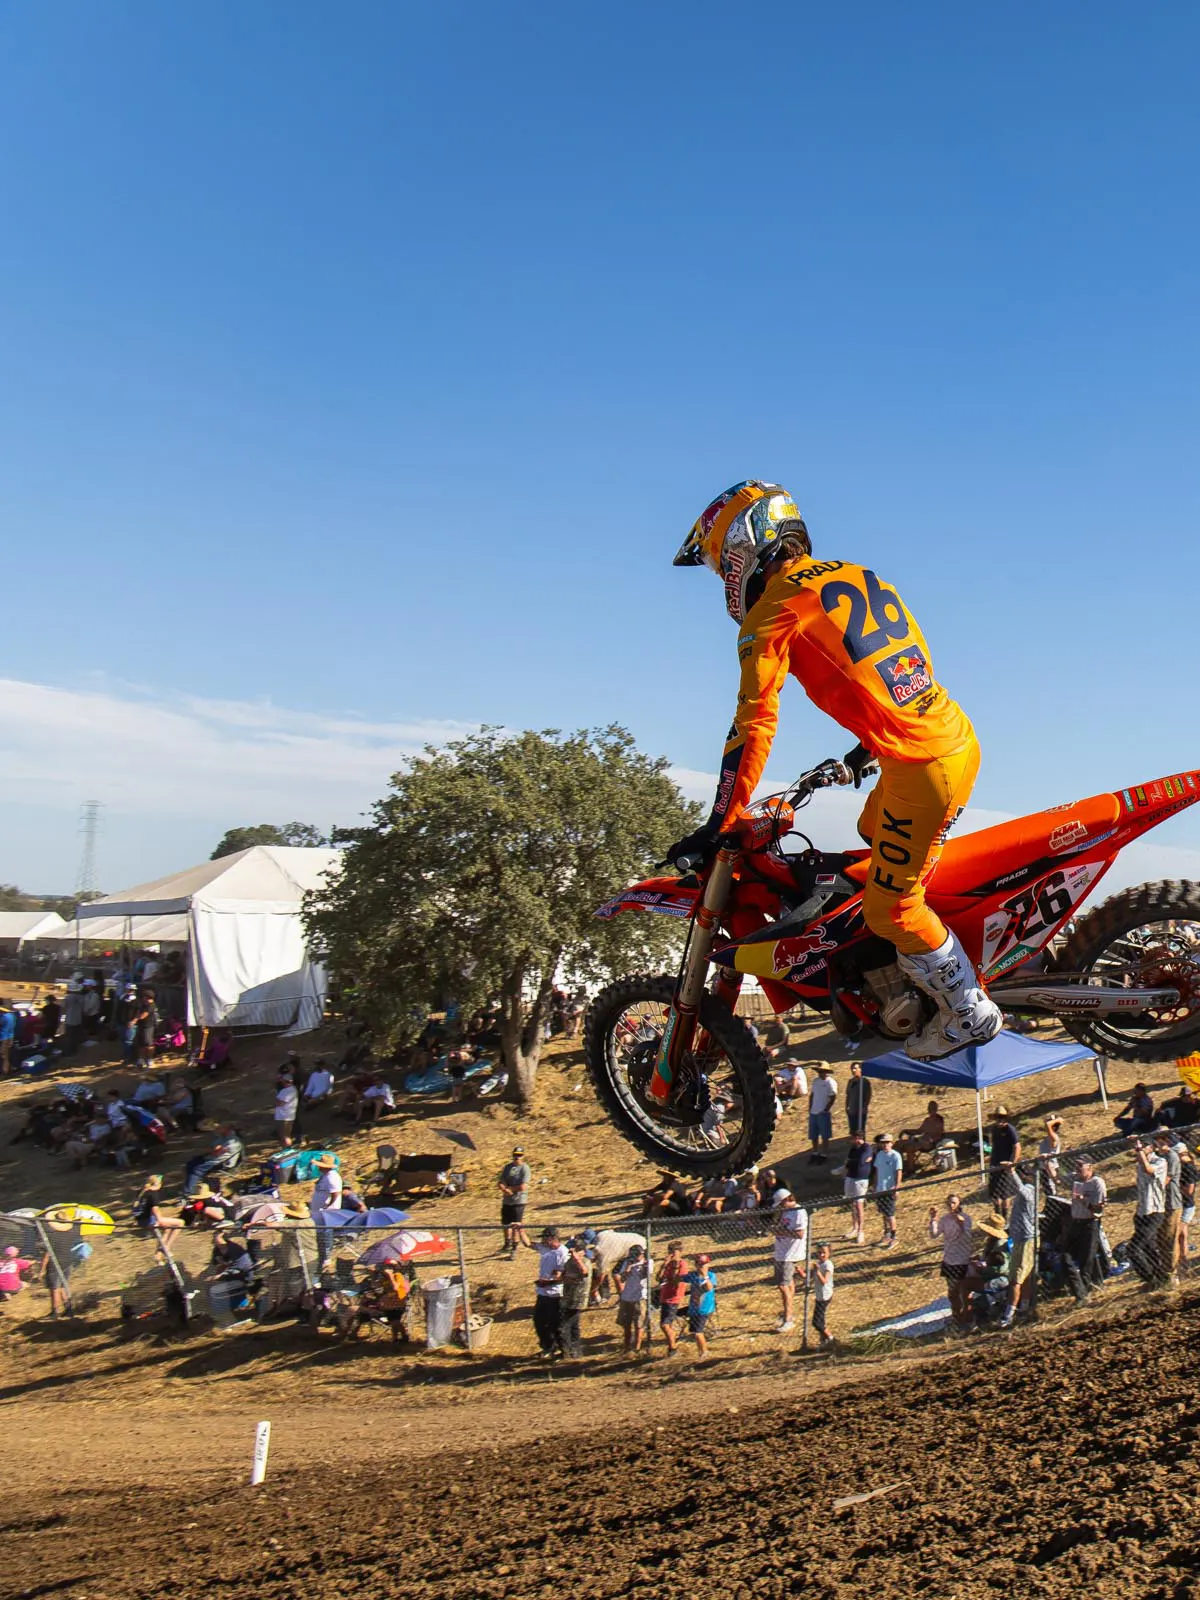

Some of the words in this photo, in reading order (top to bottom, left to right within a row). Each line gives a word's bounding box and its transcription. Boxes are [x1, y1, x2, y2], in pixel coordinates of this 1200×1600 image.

[725, 550, 745, 585] Bull
[786, 560, 854, 587] PRAD
[821, 569, 910, 665] 26
[893, 676, 918, 704] Red
[720, 769, 736, 792] Bull
[714, 788, 730, 815] Red
[873, 808, 913, 893] FOX
[996, 868, 1028, 887] PRADO
[1004, 870, 1073, 942] 26
[792, 967, 812, 983] Red
[808, 959, 827, 975] Bull
[999, 948, 1030, 971] MOTOREX
[941, 964, 962, 984] FOX
